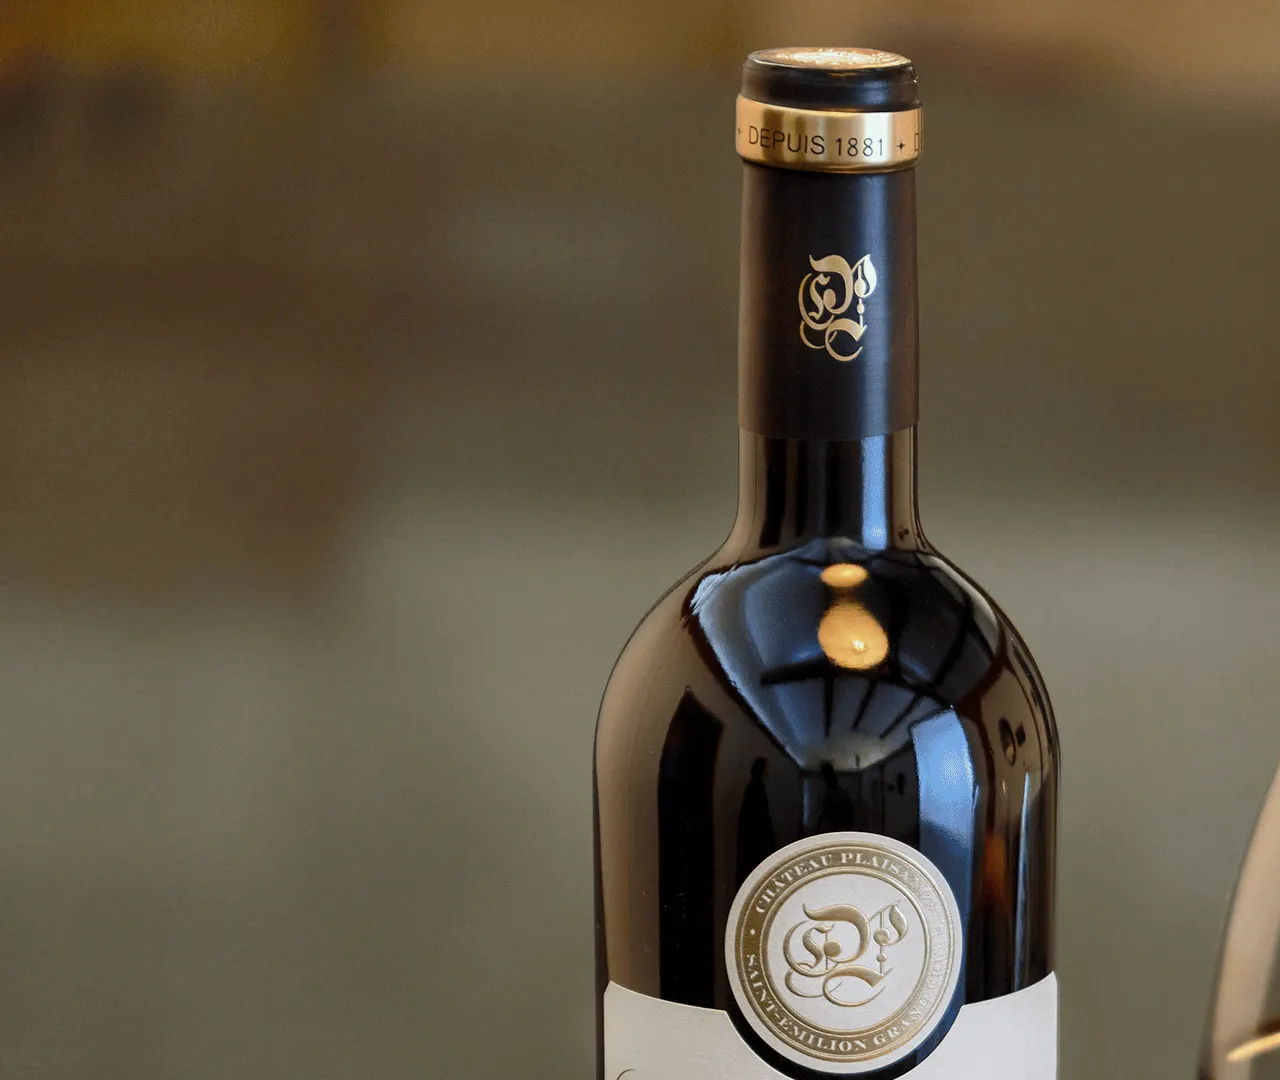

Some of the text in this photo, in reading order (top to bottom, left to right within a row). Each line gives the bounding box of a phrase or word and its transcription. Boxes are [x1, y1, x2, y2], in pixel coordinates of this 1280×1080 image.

[748, 125, 883, 157] DEPUIS 1881
[756, 853, 833, 915] CHÂTEAU
[747, 953, 867, 1051] SAINT-ÉMILION
[873, 998, 929, 1045] GRAND
